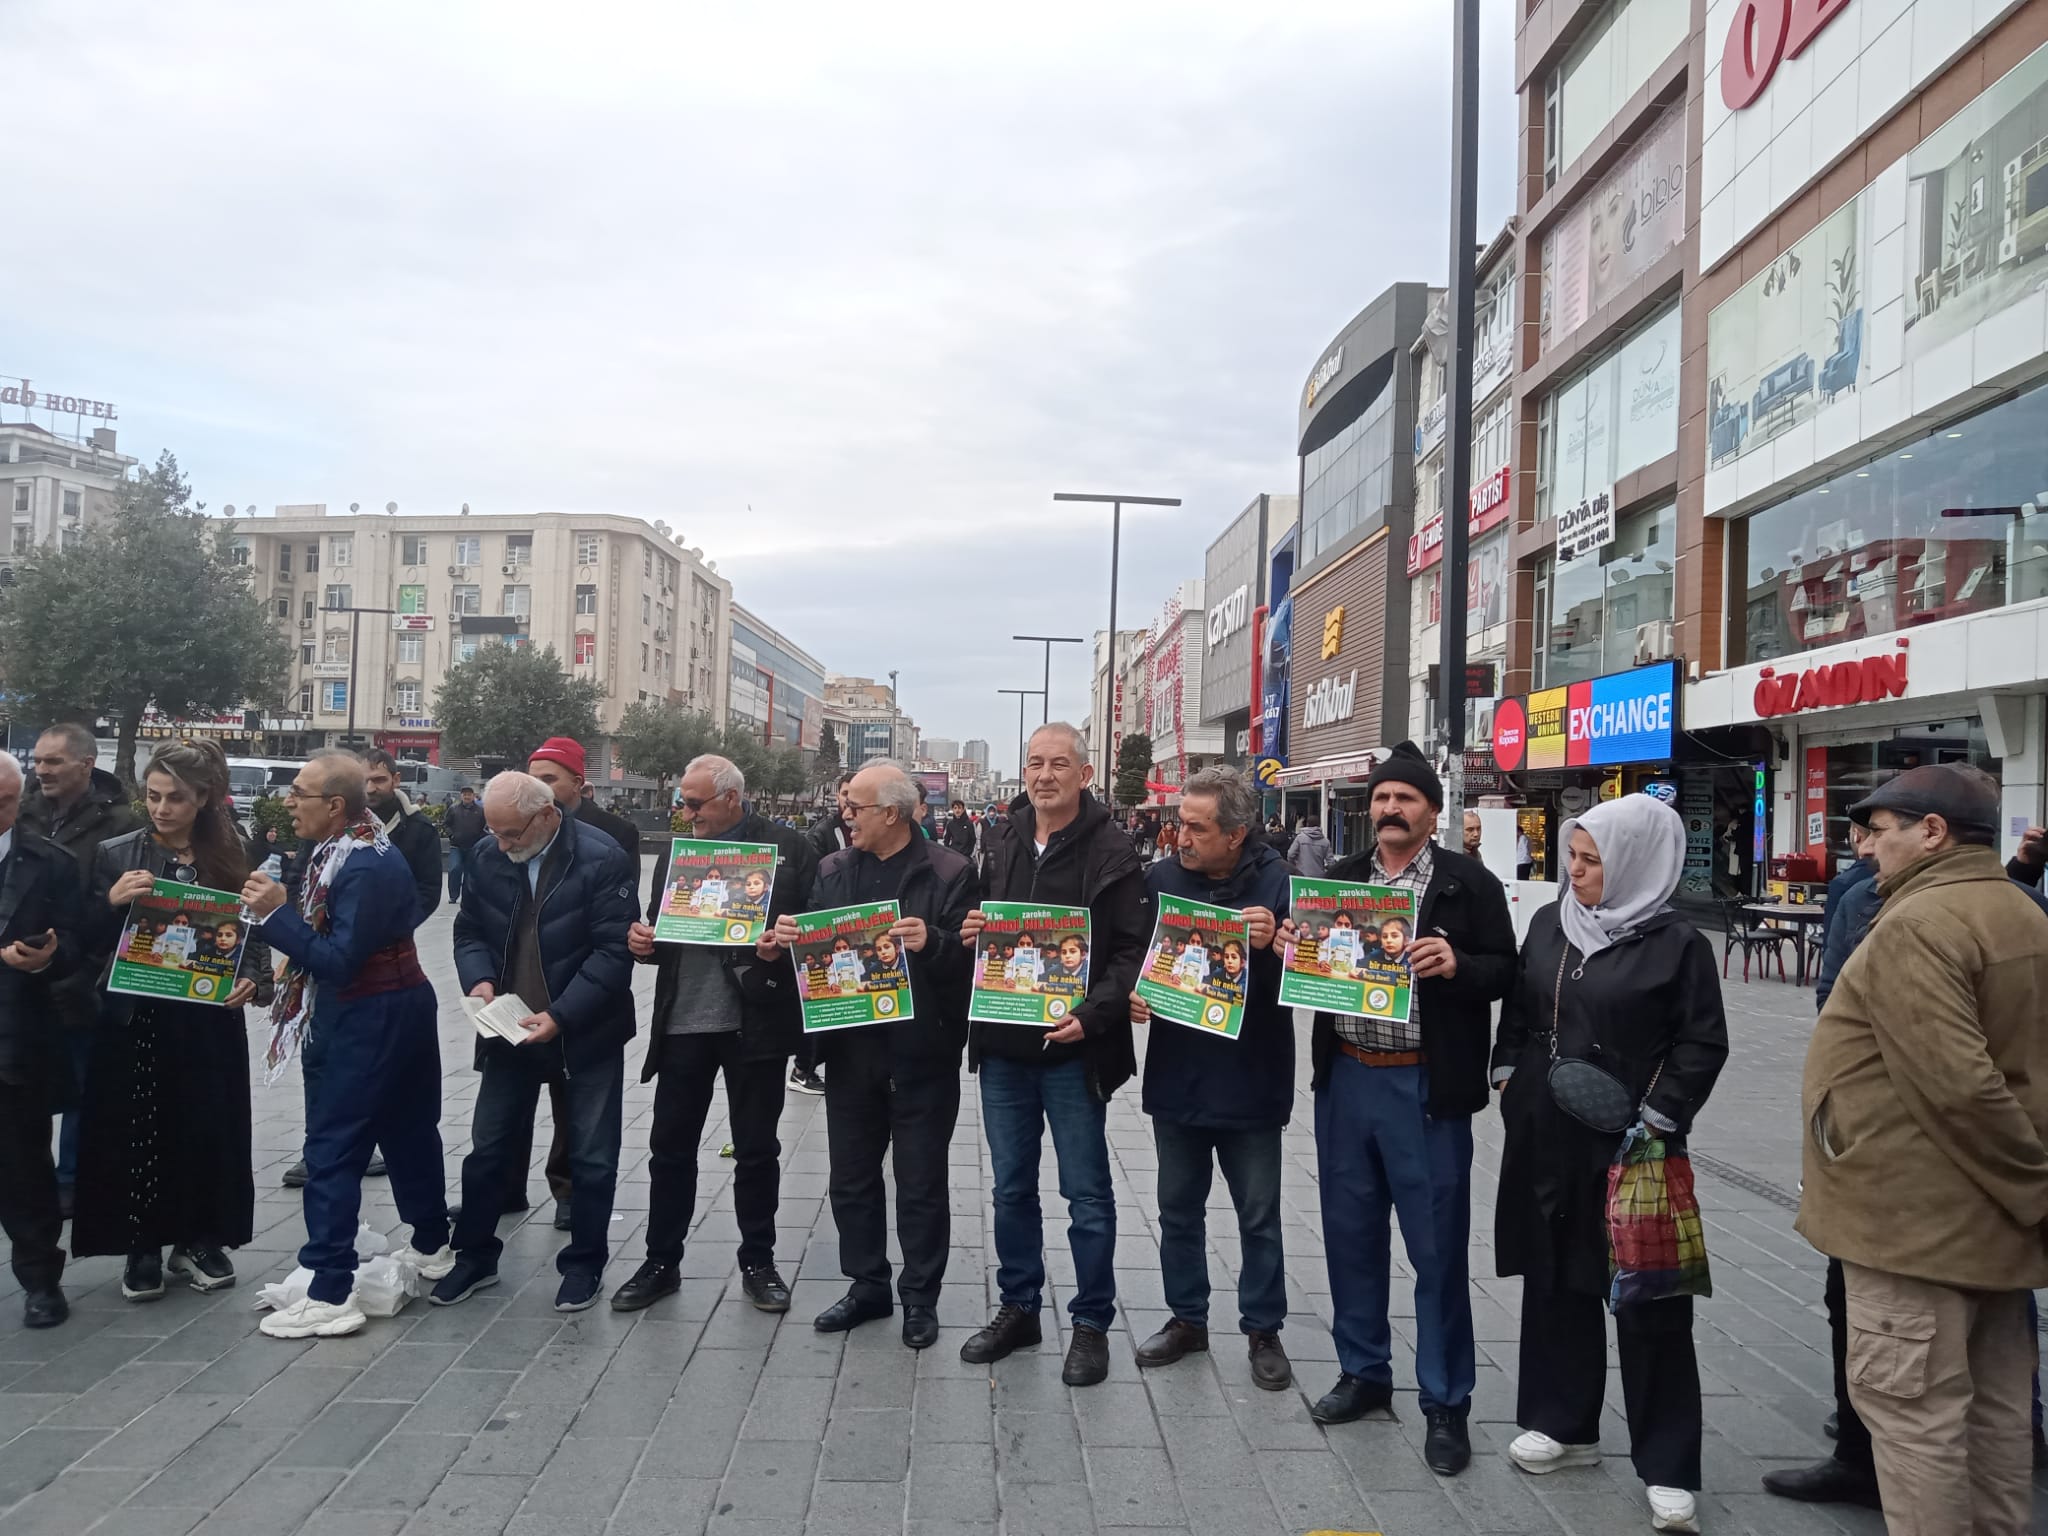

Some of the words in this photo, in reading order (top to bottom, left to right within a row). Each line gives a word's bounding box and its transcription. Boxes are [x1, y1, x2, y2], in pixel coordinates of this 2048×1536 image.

[45, 393, 118, 420] HOTEL
[1303, 668, 1359, 729] istikbal
[1529, 709, 1560, 725] WESTERN
[1569, 692, 1671, 741] EXCHANGE
[1537, 722, 1560, 736] UNION
[1308, 888, 1319, 897] bo
